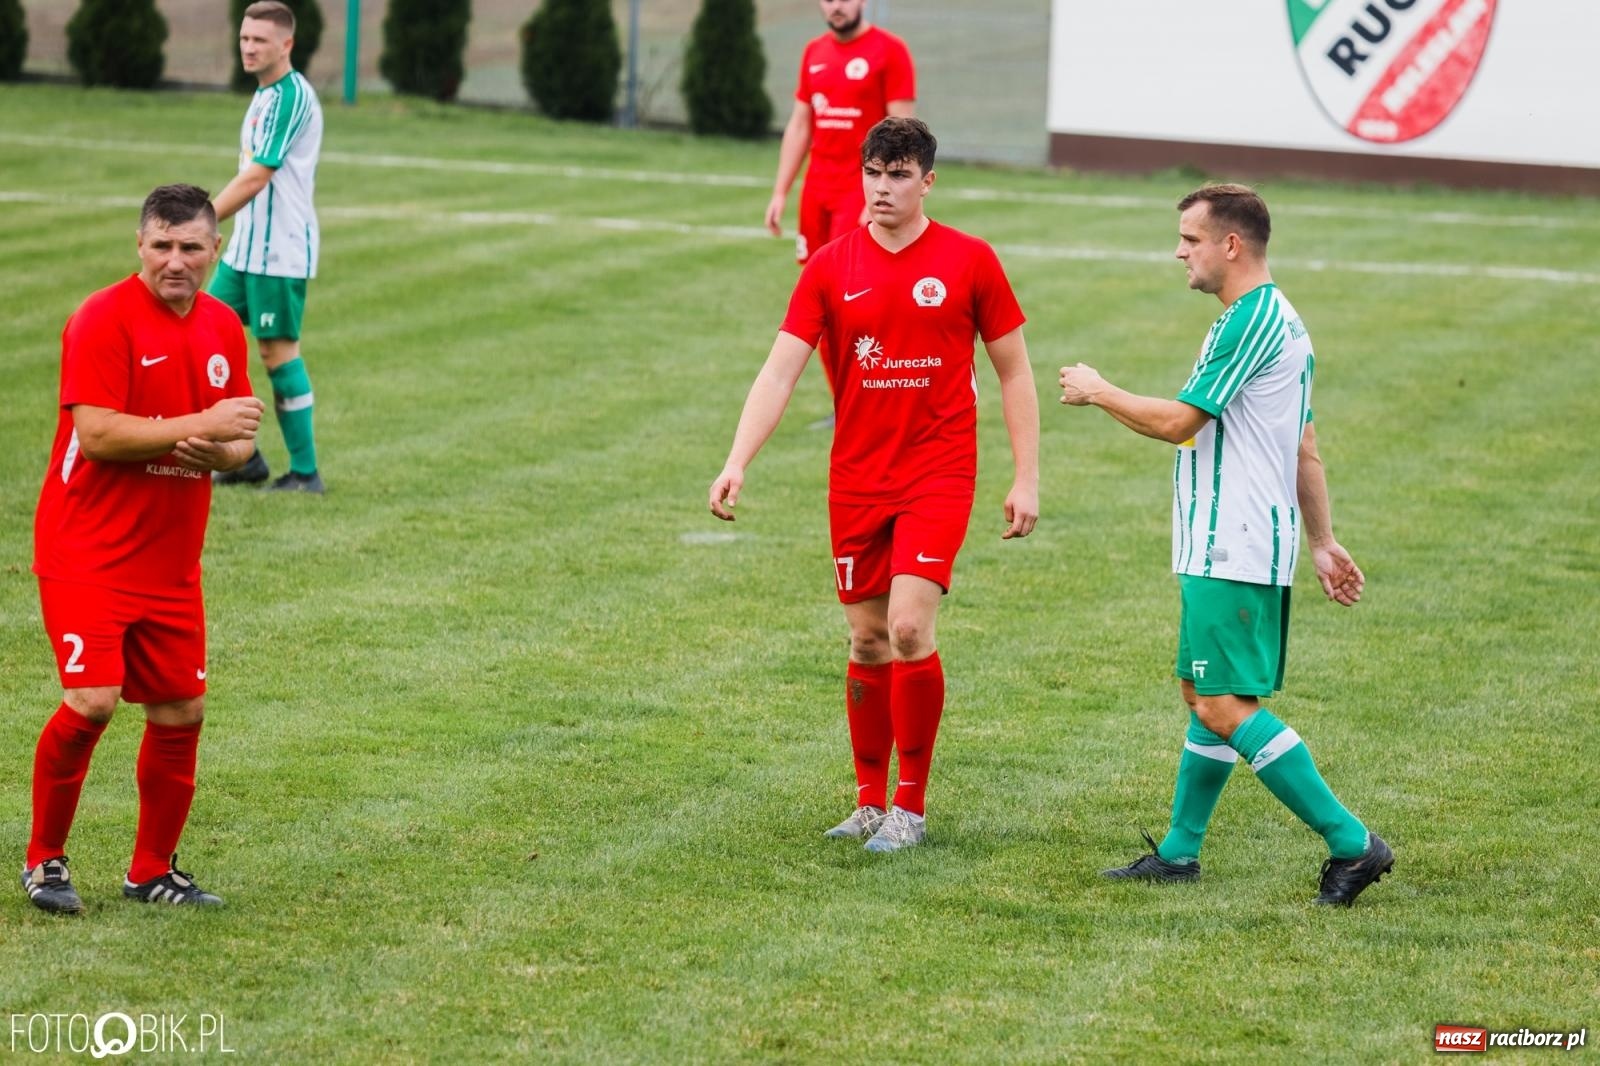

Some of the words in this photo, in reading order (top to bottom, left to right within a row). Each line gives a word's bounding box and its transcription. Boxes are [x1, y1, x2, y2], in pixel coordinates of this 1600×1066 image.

[882, 355, 942, 369] Jureczka
[862, 378, 930, 389] KLIMATYZACJE
[62, 633, 86, 673] 2
